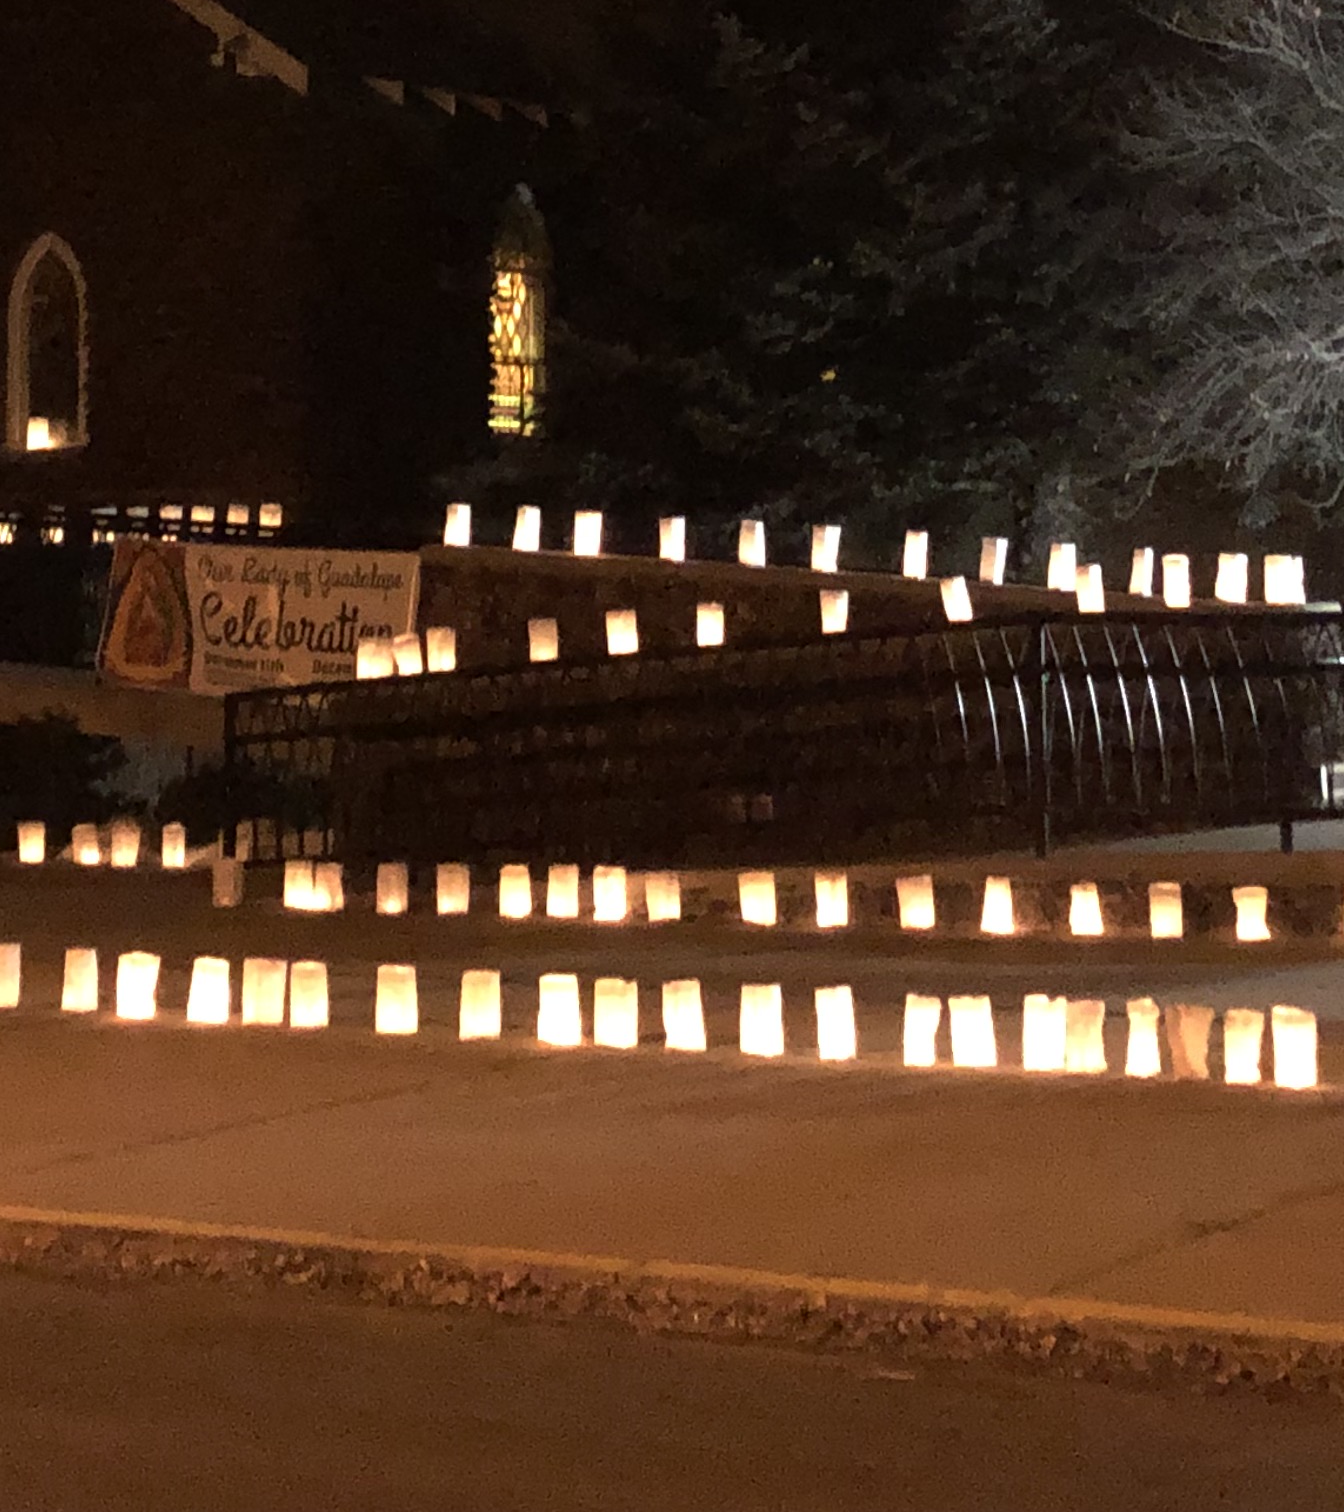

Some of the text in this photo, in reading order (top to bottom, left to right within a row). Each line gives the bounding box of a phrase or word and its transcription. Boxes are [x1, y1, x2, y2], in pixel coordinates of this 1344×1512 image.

[197, 554, 235, 583] Our
[240, 557, 290, 595] Lady
[294, 558, 312, 598] of
